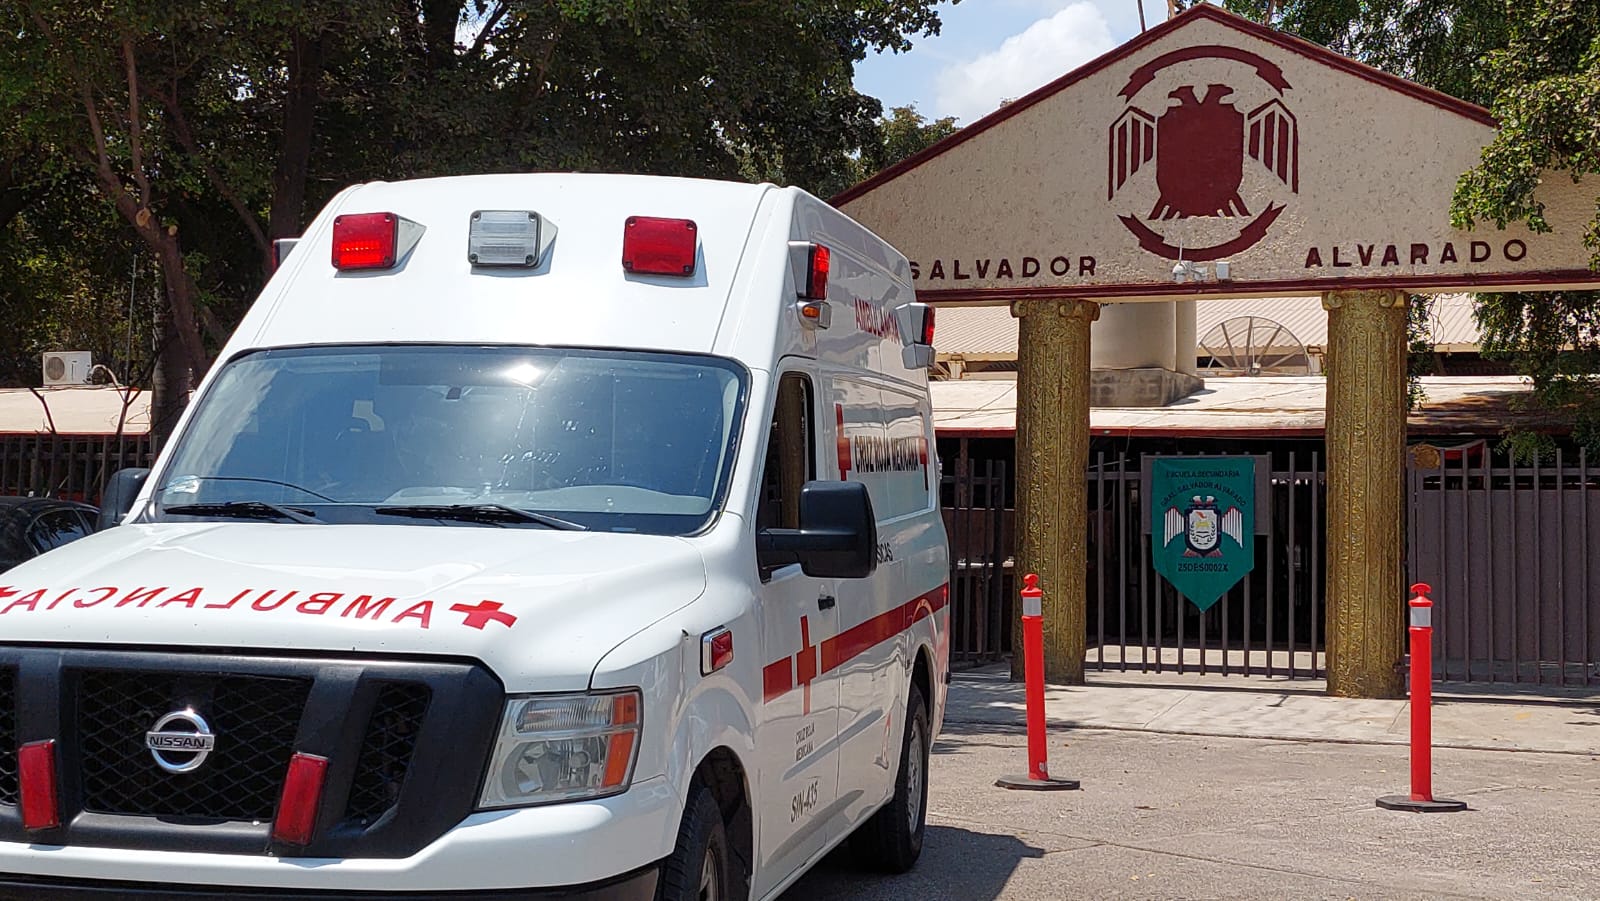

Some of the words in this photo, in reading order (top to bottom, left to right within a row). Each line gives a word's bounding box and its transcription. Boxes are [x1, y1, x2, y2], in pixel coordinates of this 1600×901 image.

[909, 256, 1097, 281] SALVADOR
[1305, 239, 1528, 269] ALVARADO
[854, 435, 874, 473] CRUZ
[874, 435, 891, 473] ROJA
[891, 436, 919, 472] MEXICANA
[1166, 470, 1197, 478] ESCUELA
[1197, 470, 1240, 478] SECUNDARIA
[1178, 481, 1214, 493] SALVADOR
[1213, 482, 1247, 506] ALVARADO
[1178, 562, 1229, 573] 25DES0002X
[149, 736, 206, 748] NISSAN
[795, 727, 806, 744] CRUZ
[805, 722, 815, 738] ROJA
[795, 740, 814, 761] MEXICANA
[790, 780, 818, 823] SIN-435
